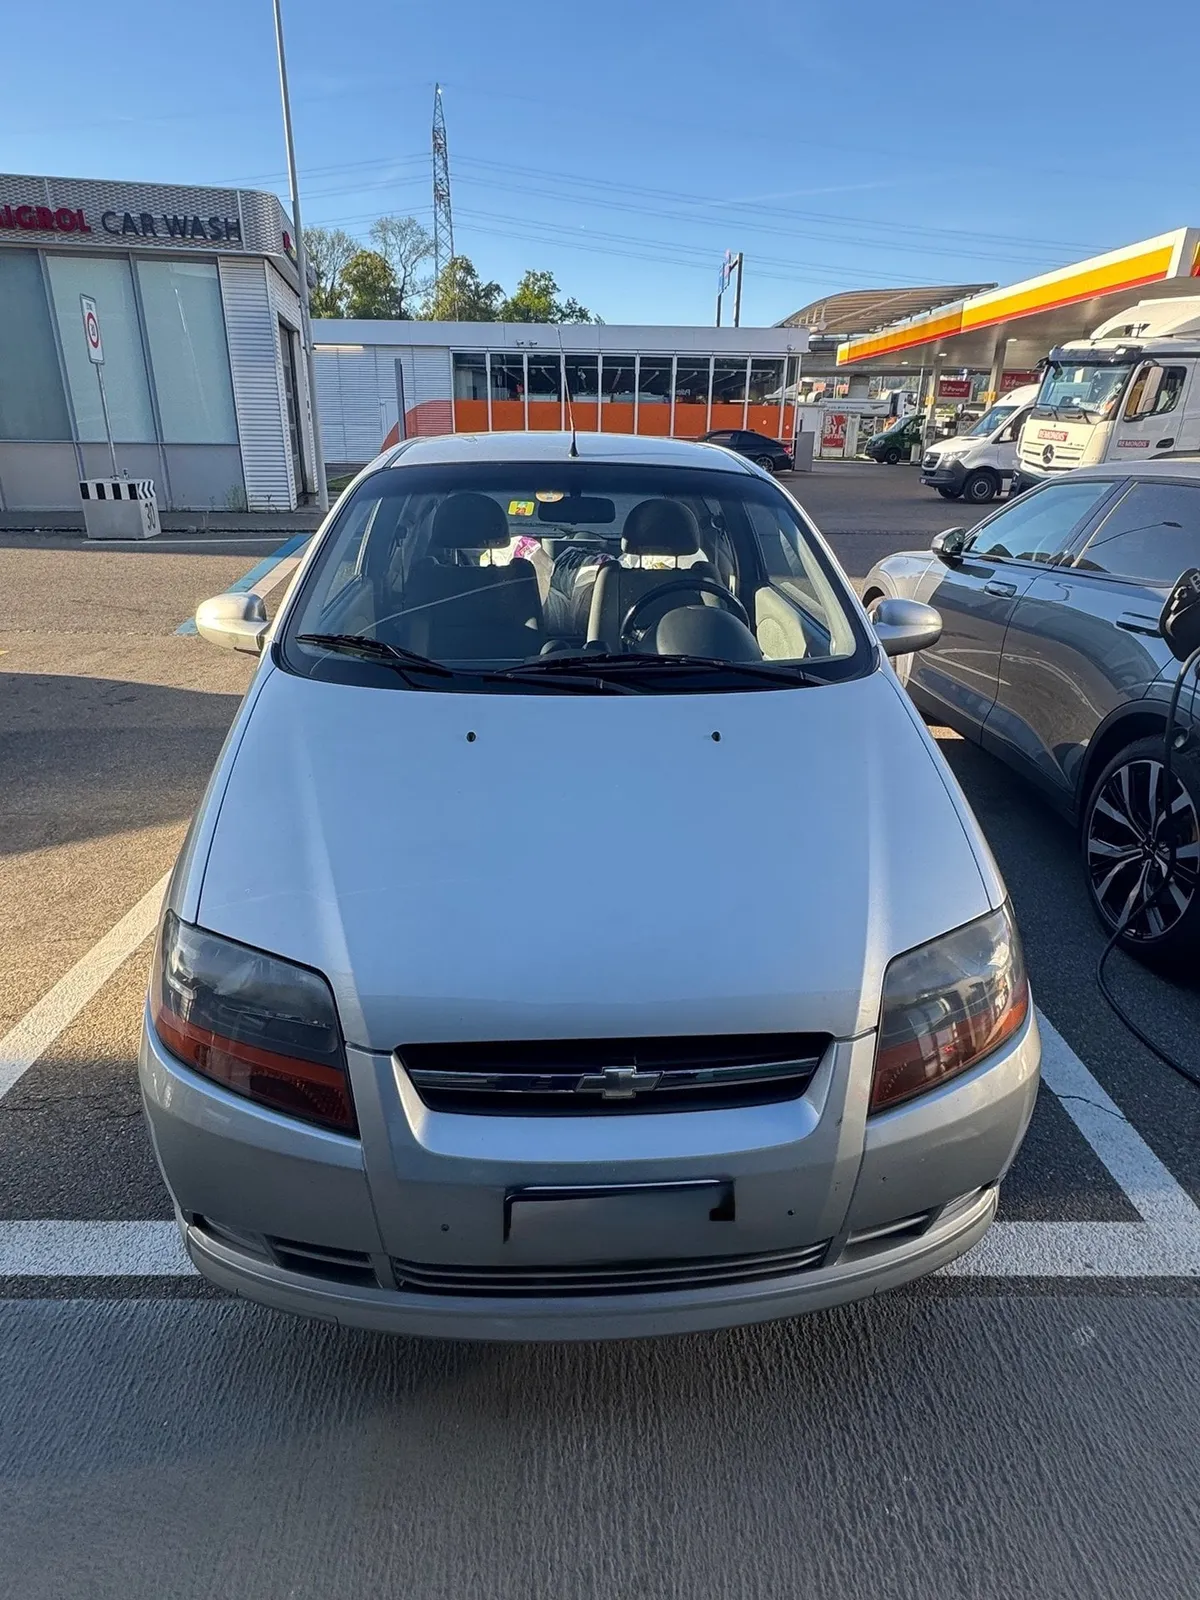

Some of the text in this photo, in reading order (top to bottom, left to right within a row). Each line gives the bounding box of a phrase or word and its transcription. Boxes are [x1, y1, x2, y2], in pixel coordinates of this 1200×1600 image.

[0, 205, 242, 241] IGROL CAR WASH
[145, 501, 156, 531] 30
